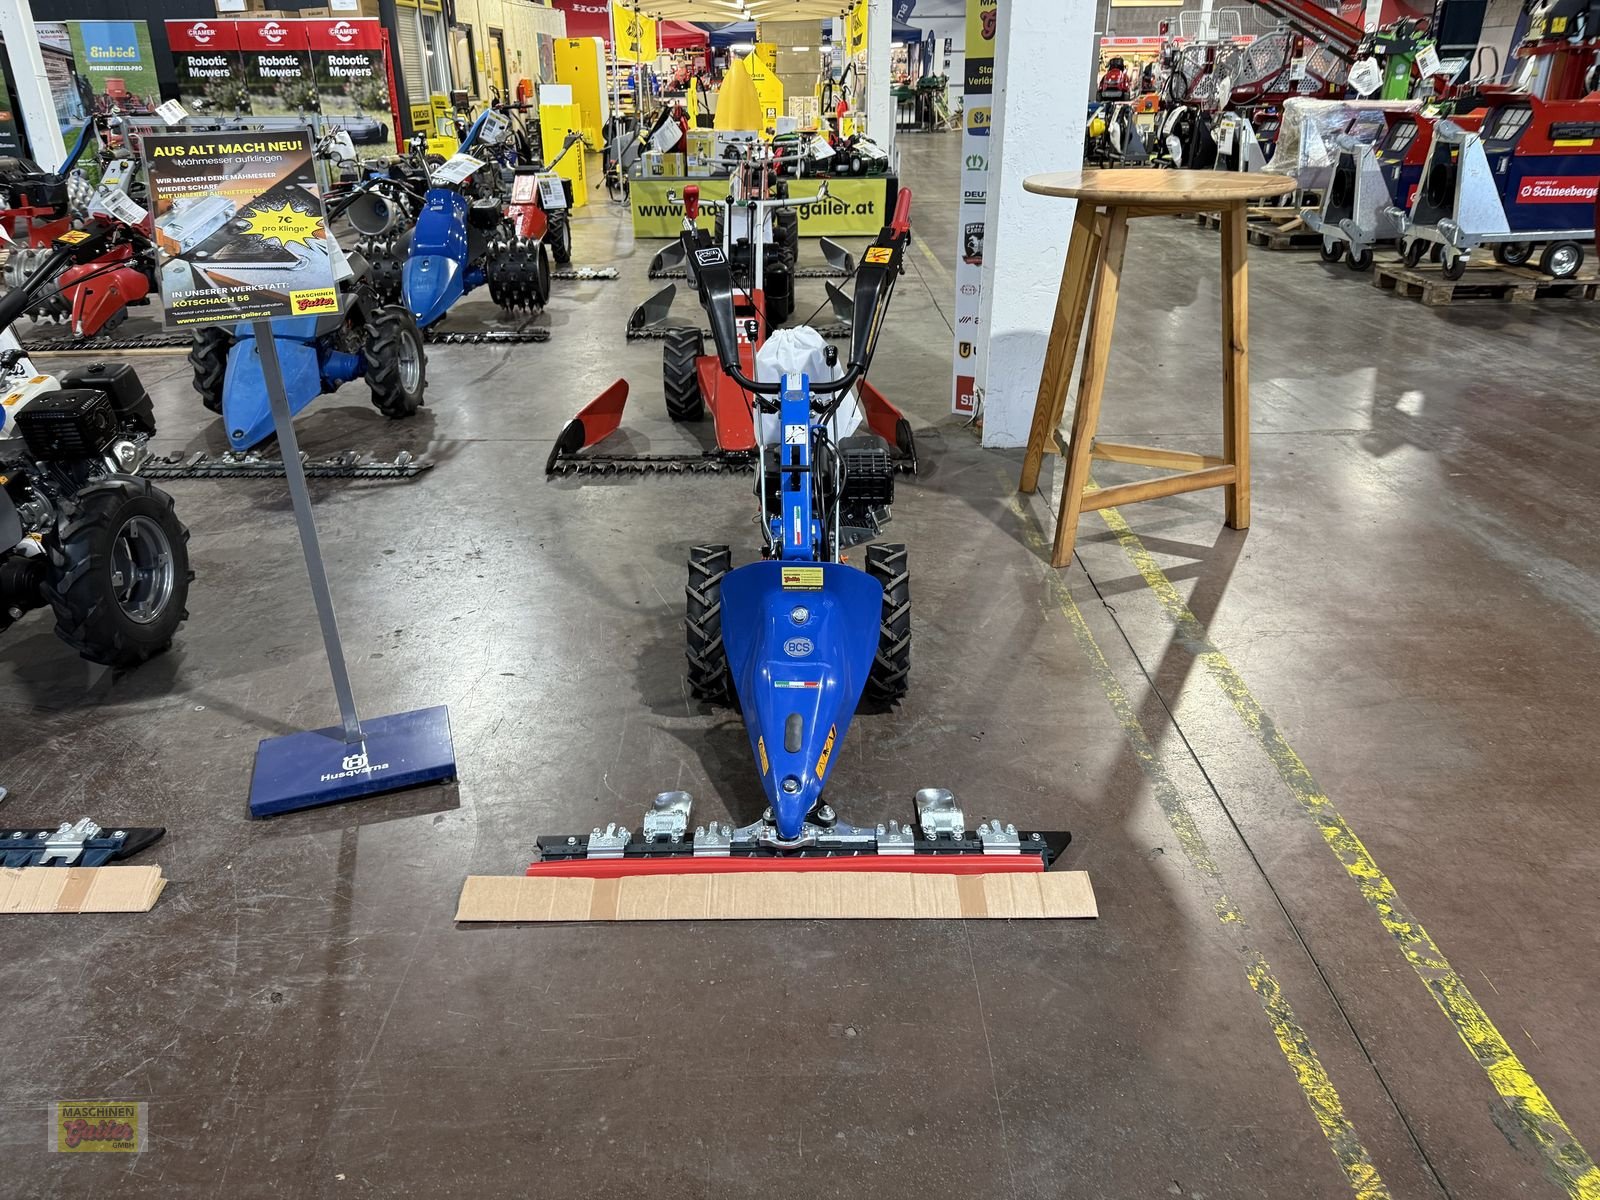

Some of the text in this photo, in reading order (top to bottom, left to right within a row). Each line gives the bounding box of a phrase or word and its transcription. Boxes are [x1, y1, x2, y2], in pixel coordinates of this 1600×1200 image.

[187, 28, 215, 36] CRAMER
[258, 28, 288, 36] CRAMER
[329, 28, 358, 36] CRAMER
[187, 55, 227, 66] Robotic
[258, 55, 299, 66] Robotic
[328, 54, 369, 65] Robotic
[189, 66, 230, 77] Mowers
[259, 66, 300, 77] Mowers
[329, 66, 371, 77] Mowers
[153, 140, 303, 157] AUS ALT MACH NEU!
[177, 154, 283, 167] Mähmesser aufklingen
[230, 171, 277, 181] MÄHMESSER
[157, 185, 186, 193] WIEDER
[278, 216, 293, 224] 7€
[171, 282, 291, 299] IN UNSERER WERKSTATT:
[295, 291, 334, 299] MASCHINEN
[237, 294, 250, 302] 56
[788, 642, 810, 652] BCS
[320, 762, 389, 781] Husqvarna
